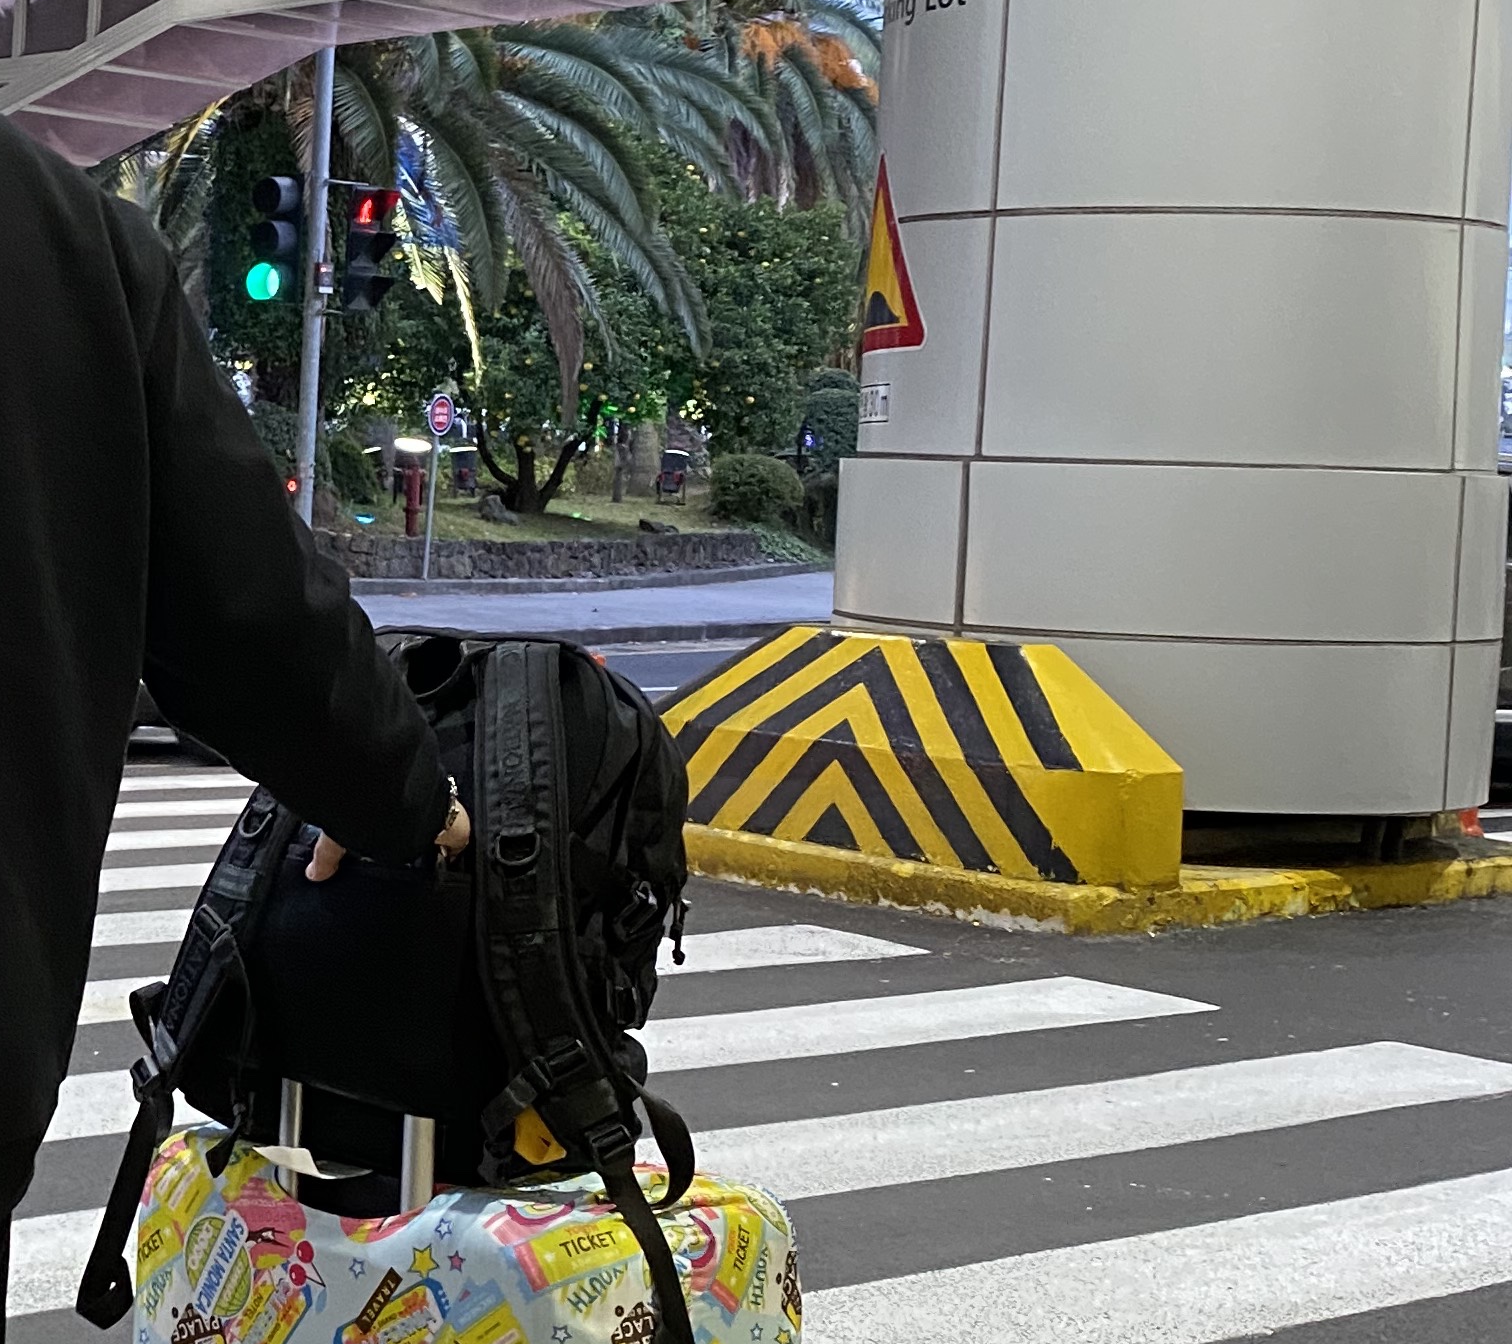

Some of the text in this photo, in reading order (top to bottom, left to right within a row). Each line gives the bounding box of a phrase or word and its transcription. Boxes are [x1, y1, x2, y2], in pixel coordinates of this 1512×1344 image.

[138, 1229, 165, 1263] ICKET
[216, 1217, 244, 1264] SANTA
[559, 1230, 618, 1258] TICKET
[733, 1224, 750, 1272] TICKET
[195, 1260, 226, 1314] MONICA
[361, 1279, 396, 1323] TRAVEL
[567, 1263, 629, 1313] YOUTH
